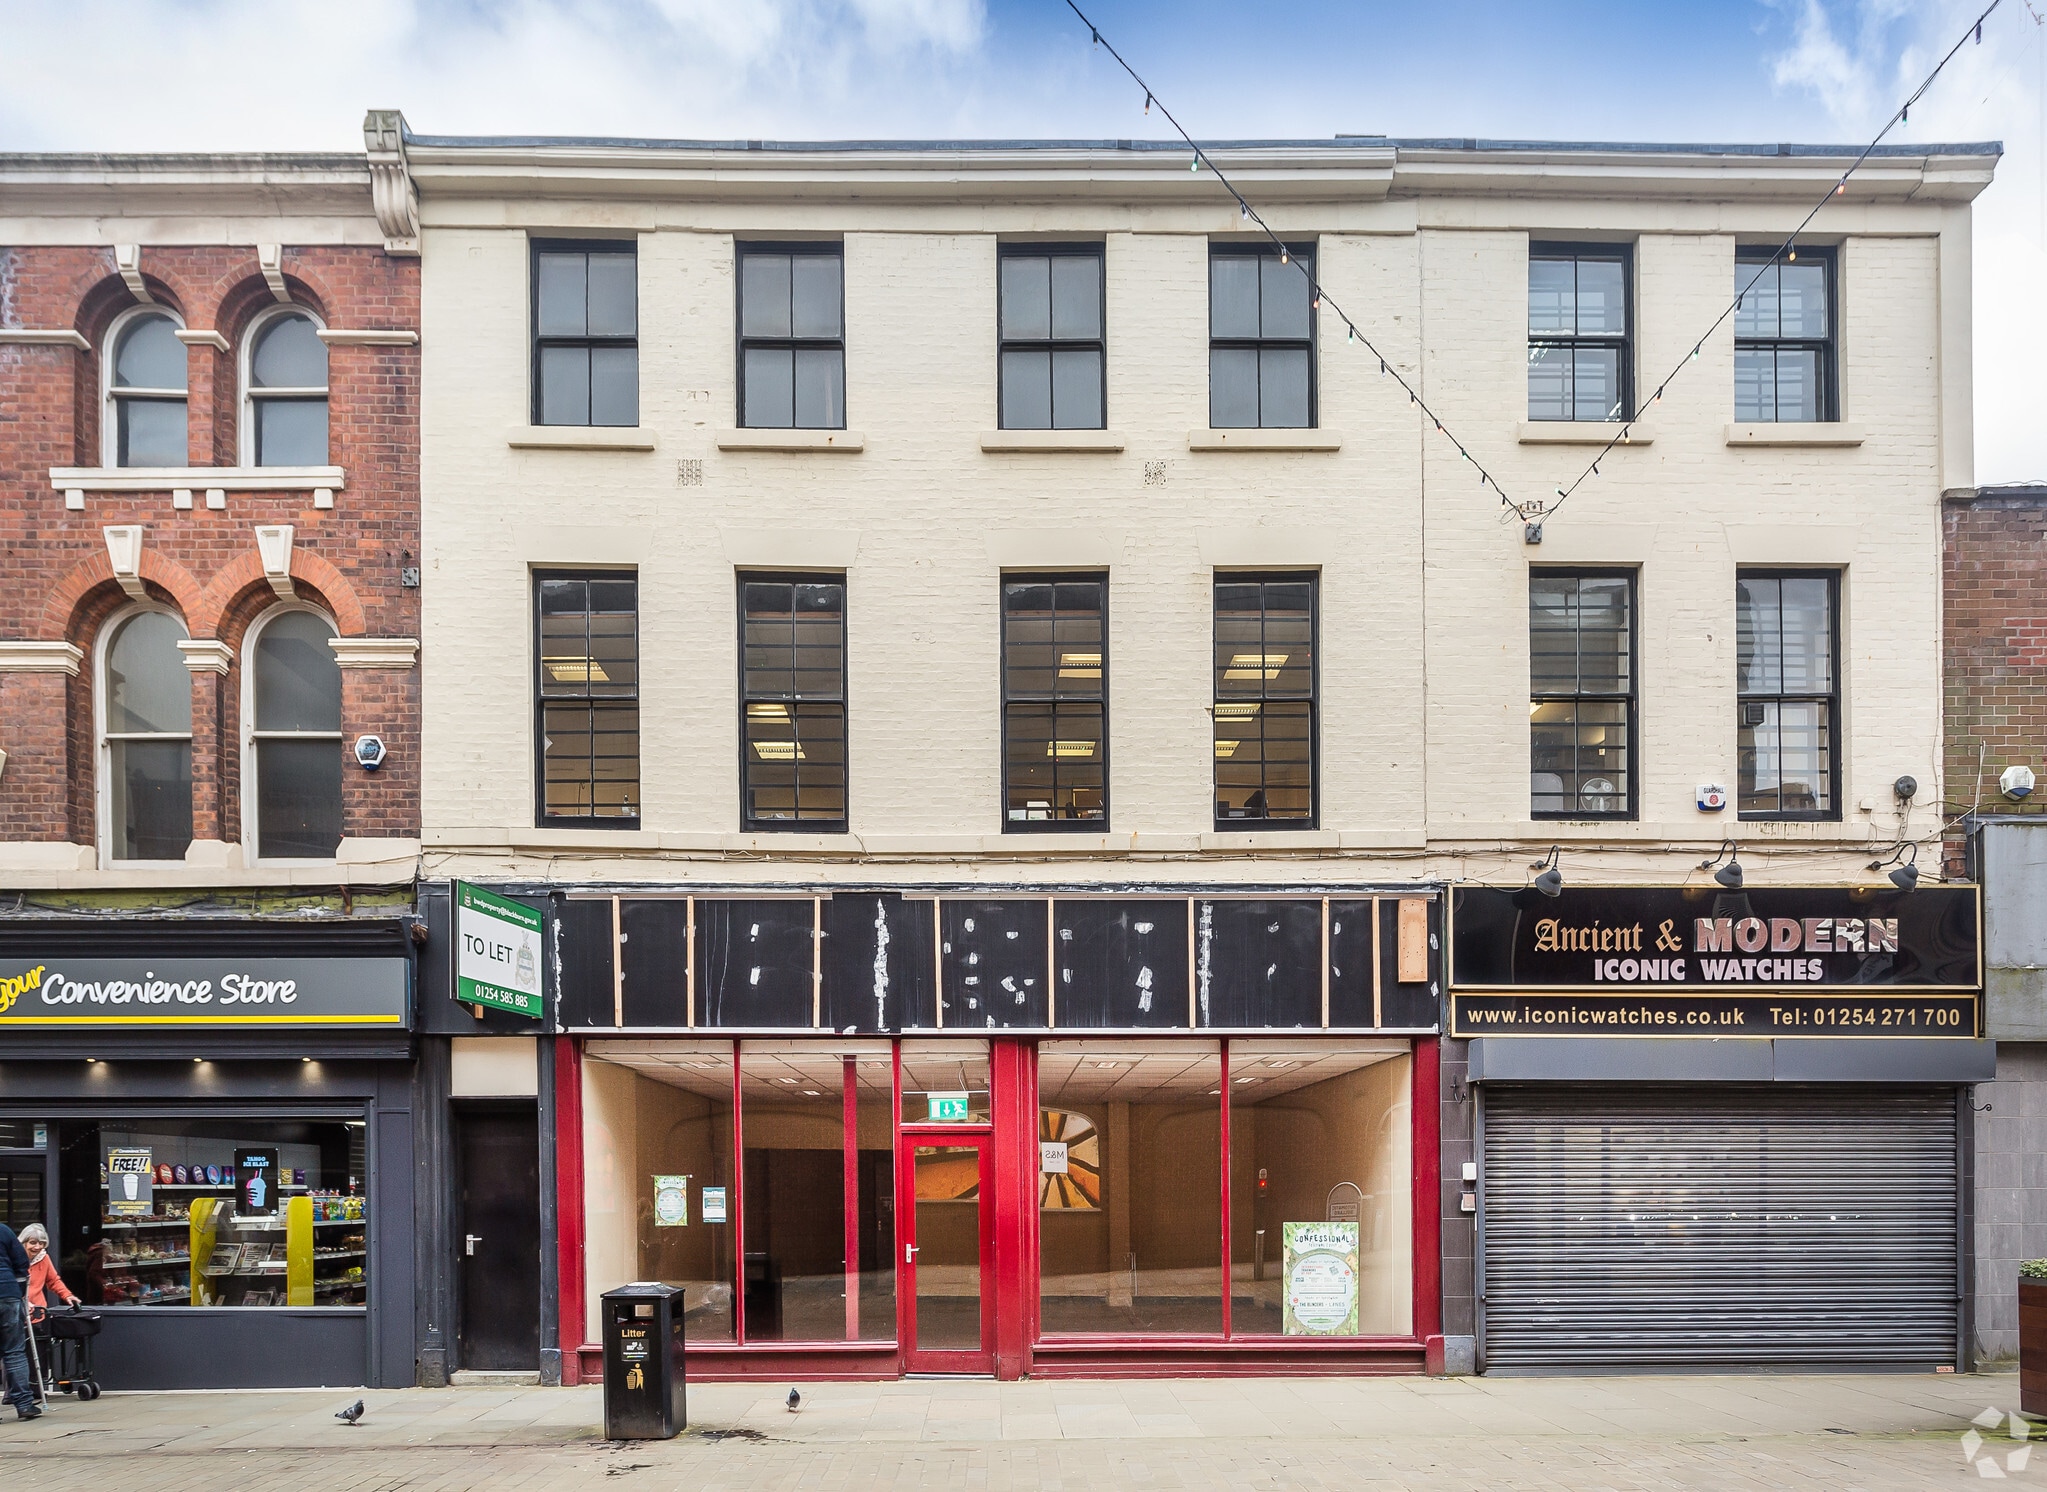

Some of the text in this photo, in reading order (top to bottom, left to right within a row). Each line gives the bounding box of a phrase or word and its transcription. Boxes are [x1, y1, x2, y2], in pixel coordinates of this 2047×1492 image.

[1535, 918, 1899, 953] Ancient & MODERN
[464, 934, 512, 963] TO LET
[1594, 958, 1824, 981] ICONIC WATCHES
[40, 971, 214, 1005] Convenience
[219, 973, 298, 1005] Store
[475, 984, 529, 1008] 01254 585 885
[1467, 1006, 1961, 1026] www.iconicwatches.co.uk Tel: 01254 271 700
[112, 1158, 149, 1172] FREE!!
[1294, 1234, 1350, 1243] CONFESSIONAL
[621, 1329, 646, 1338] Litter
